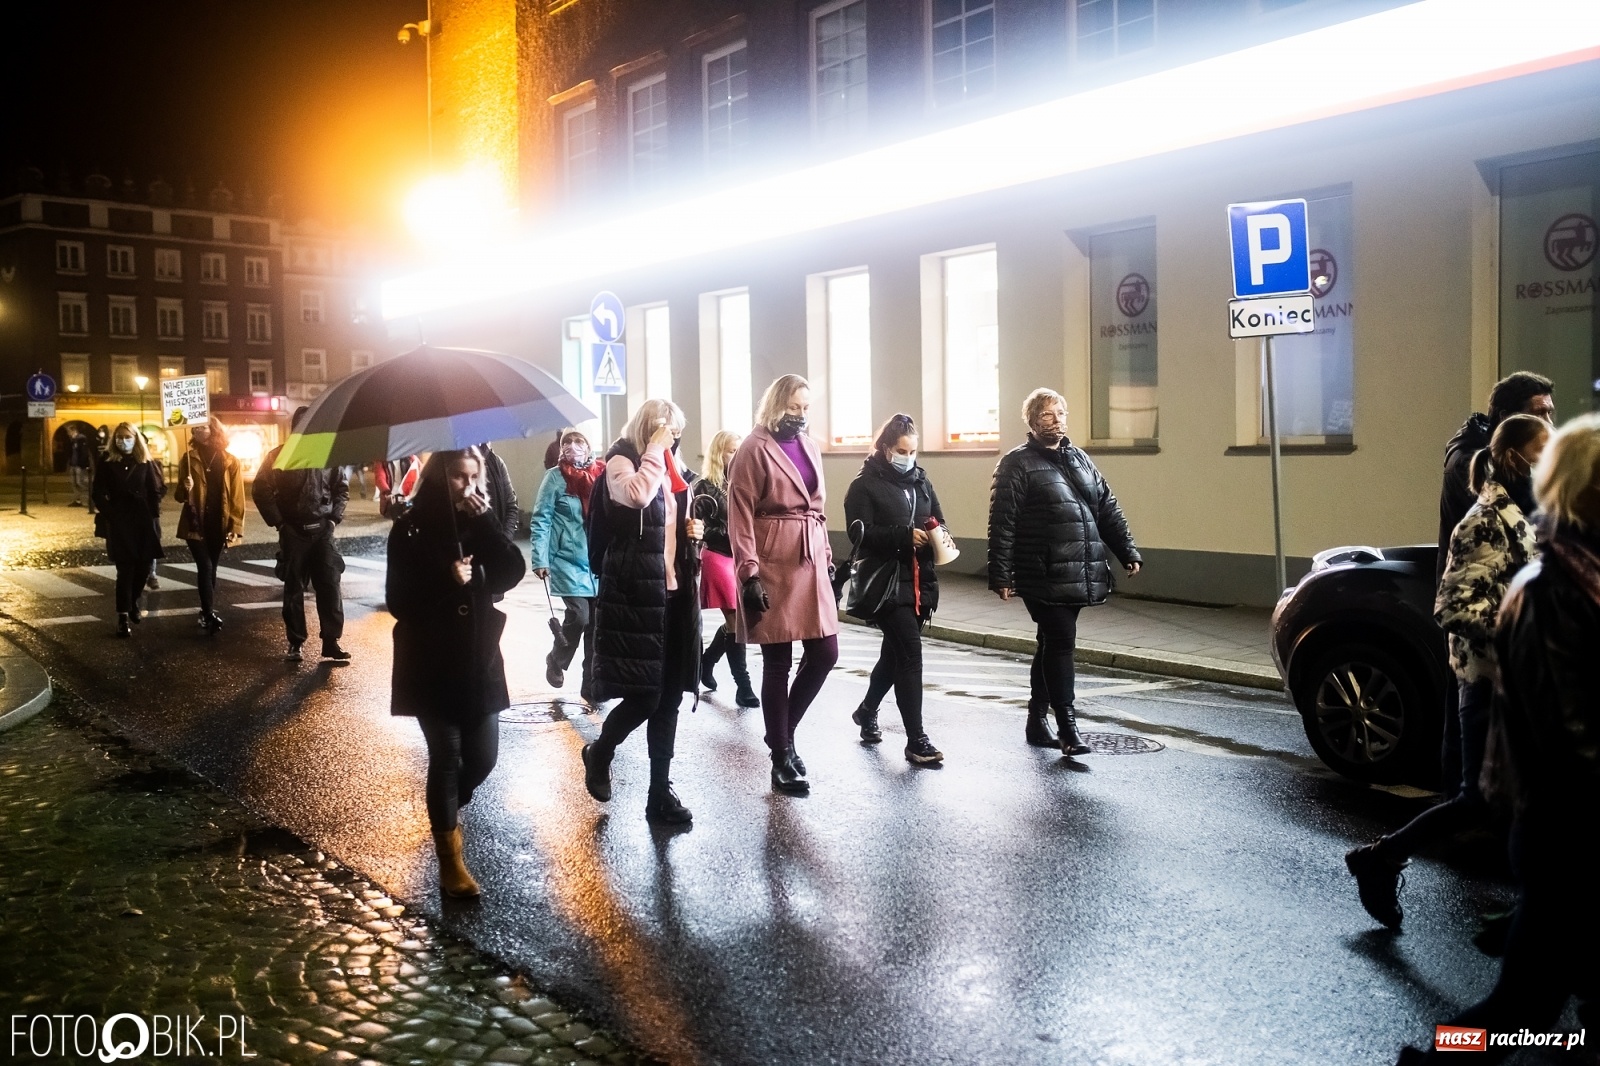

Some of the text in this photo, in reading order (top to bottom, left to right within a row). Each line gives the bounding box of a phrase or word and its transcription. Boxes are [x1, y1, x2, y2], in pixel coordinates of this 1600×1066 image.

[1246, 213, 1292, 286] P
[1515, 278, 1600, 299] ROSSMA
[1231, 305, 1312, 329] Koniec
[1100, 321, 1157, 338] ROSSMAN
[185, 379, 204, 388] SHREK
[164, 391, 174, 399] NIE
[189, 402, 206, 410] TAKIM
[188, 411, 207, 419] BAGNIE
